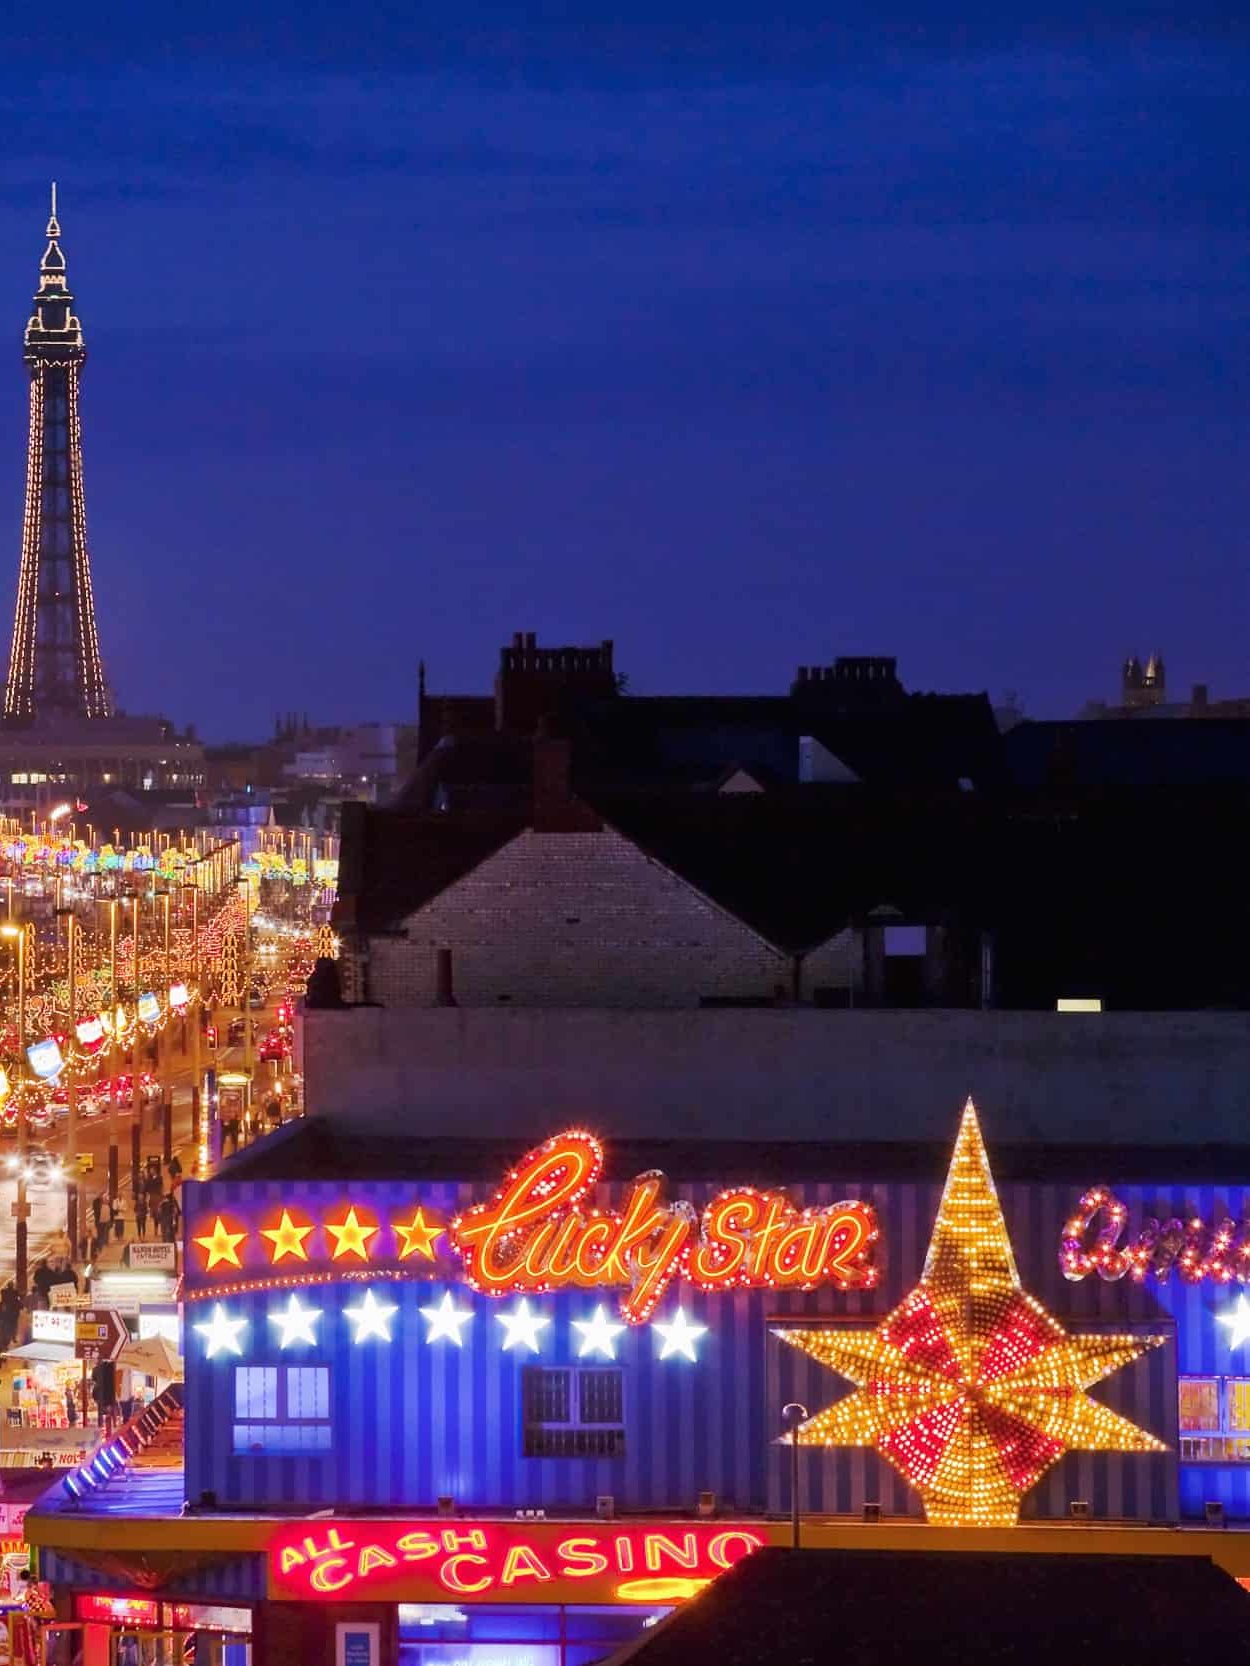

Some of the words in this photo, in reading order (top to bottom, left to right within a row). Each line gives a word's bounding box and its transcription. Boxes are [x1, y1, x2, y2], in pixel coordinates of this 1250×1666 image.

[454, 1130, 691, 1322] Lucky
[280, 1529, 355, 1572] ALL
[309, 1528, 489, 1593] CASH
[440, 1530, 764, 1593] CASINO
